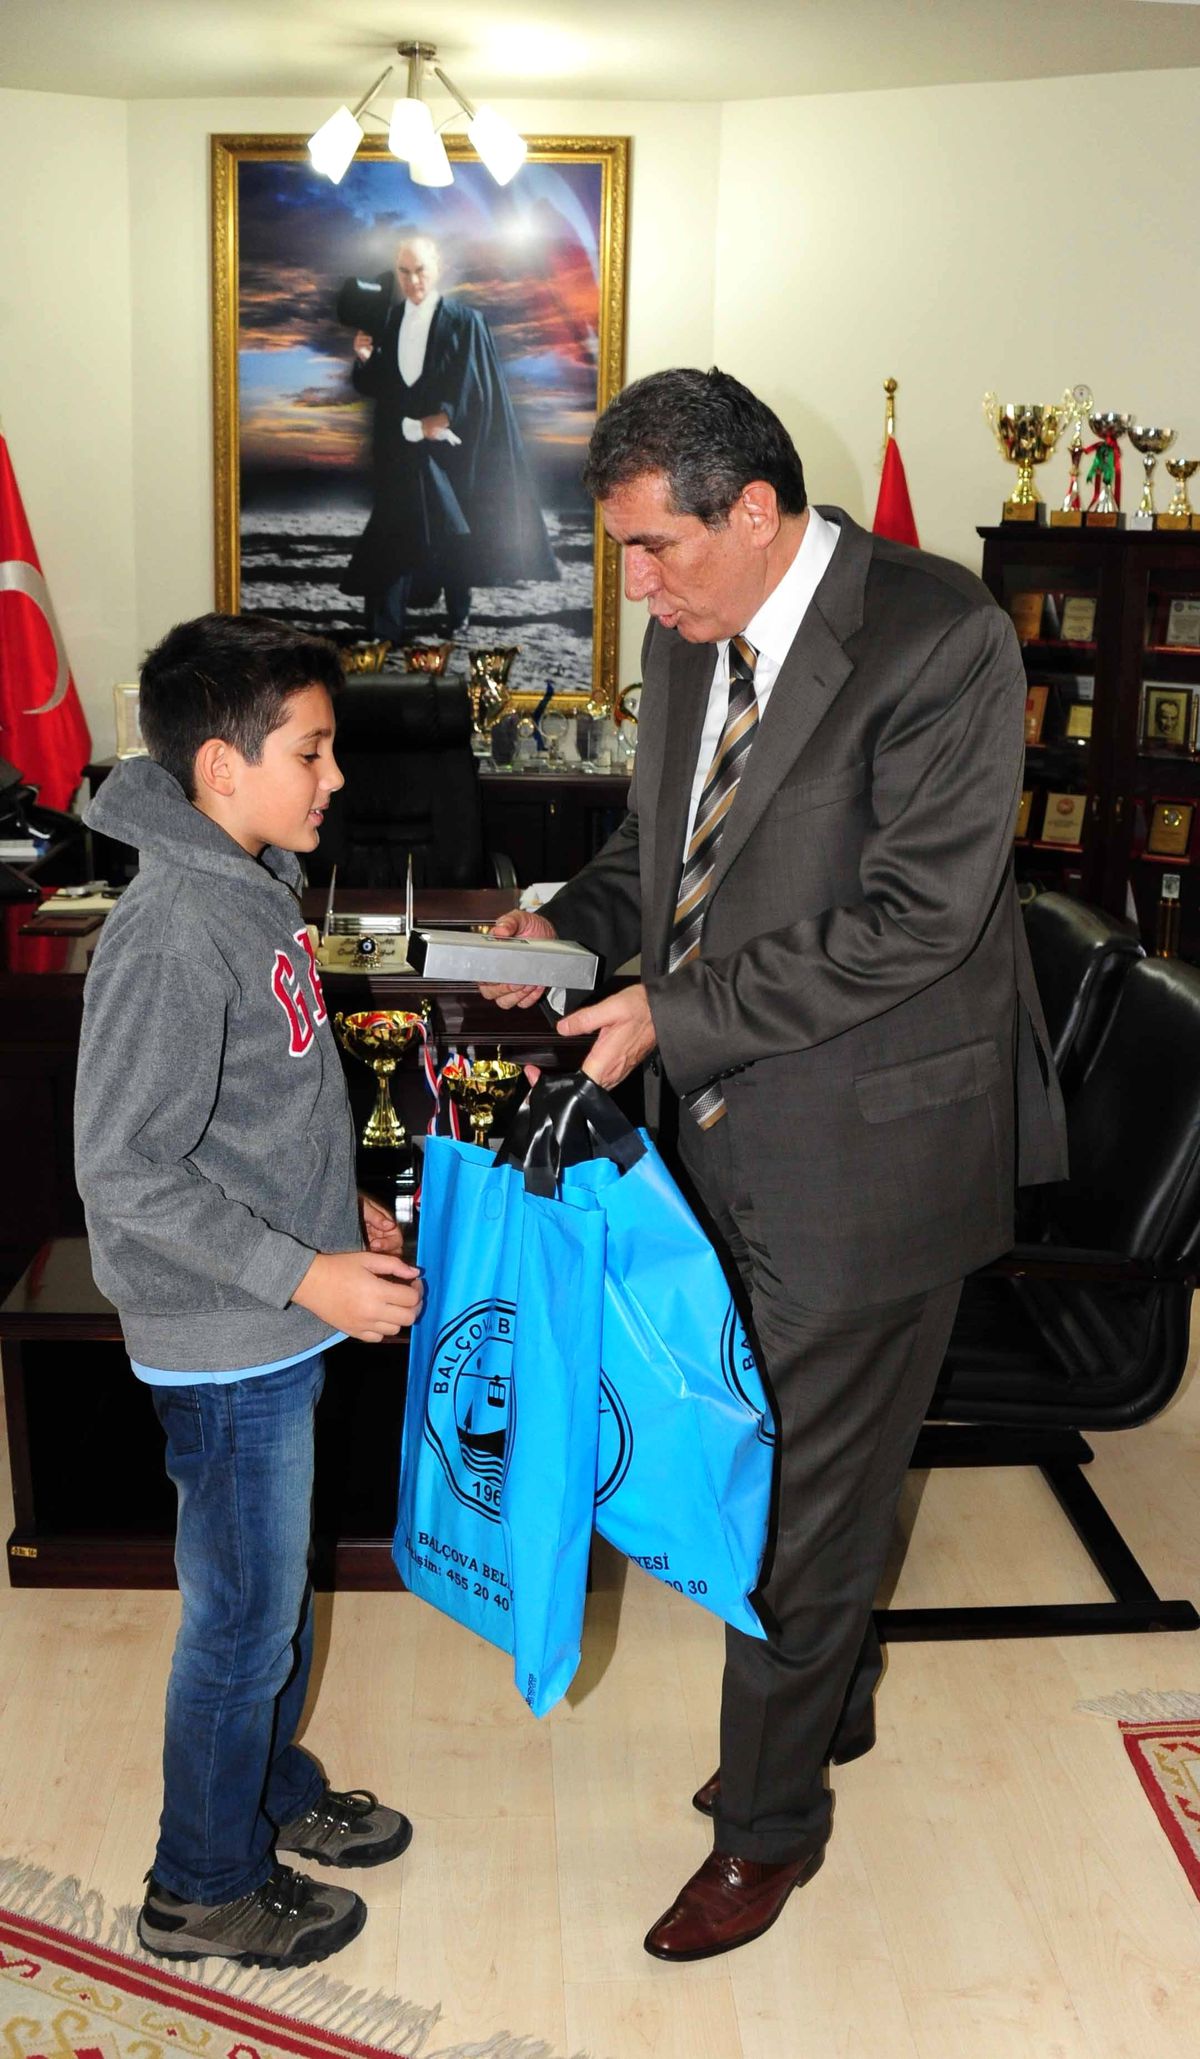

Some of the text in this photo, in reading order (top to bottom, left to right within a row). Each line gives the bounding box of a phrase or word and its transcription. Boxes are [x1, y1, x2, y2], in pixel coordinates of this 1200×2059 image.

[418, 1531, 478, 1572] BALÇOVA
[628, 1552, 670, 1570] YESİ
[447, 1569, 468, 1590] 455
[473, 1583, 489, 1600] 20
[494, 1594, 510, 1611] 40
[687, 1580, 708, 1594] 30
